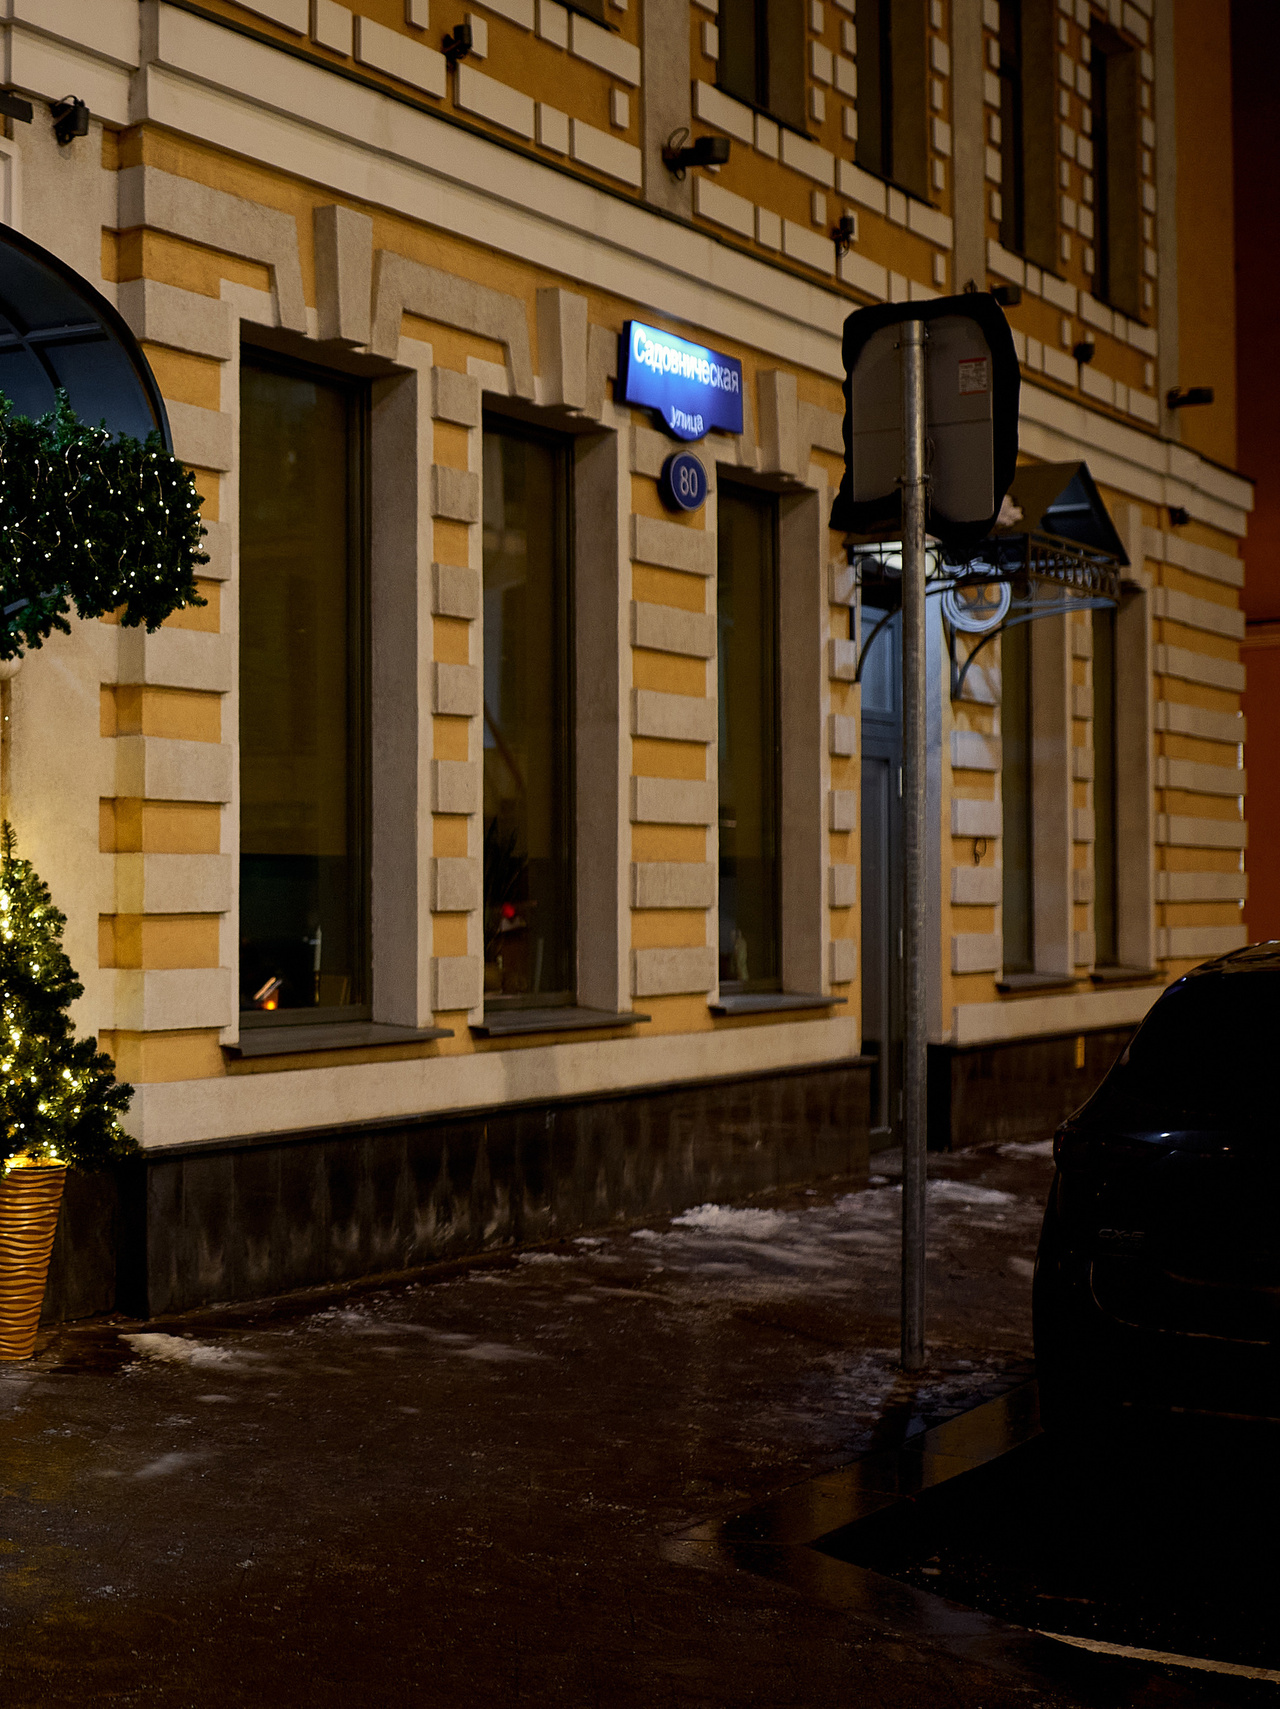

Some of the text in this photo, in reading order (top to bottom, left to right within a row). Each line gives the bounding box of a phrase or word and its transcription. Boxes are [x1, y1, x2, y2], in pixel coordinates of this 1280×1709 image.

[633, 328, 739, 393] Садовническая
[670, 405, 704, 436] улица
[680, 466, 698, 498] 80
